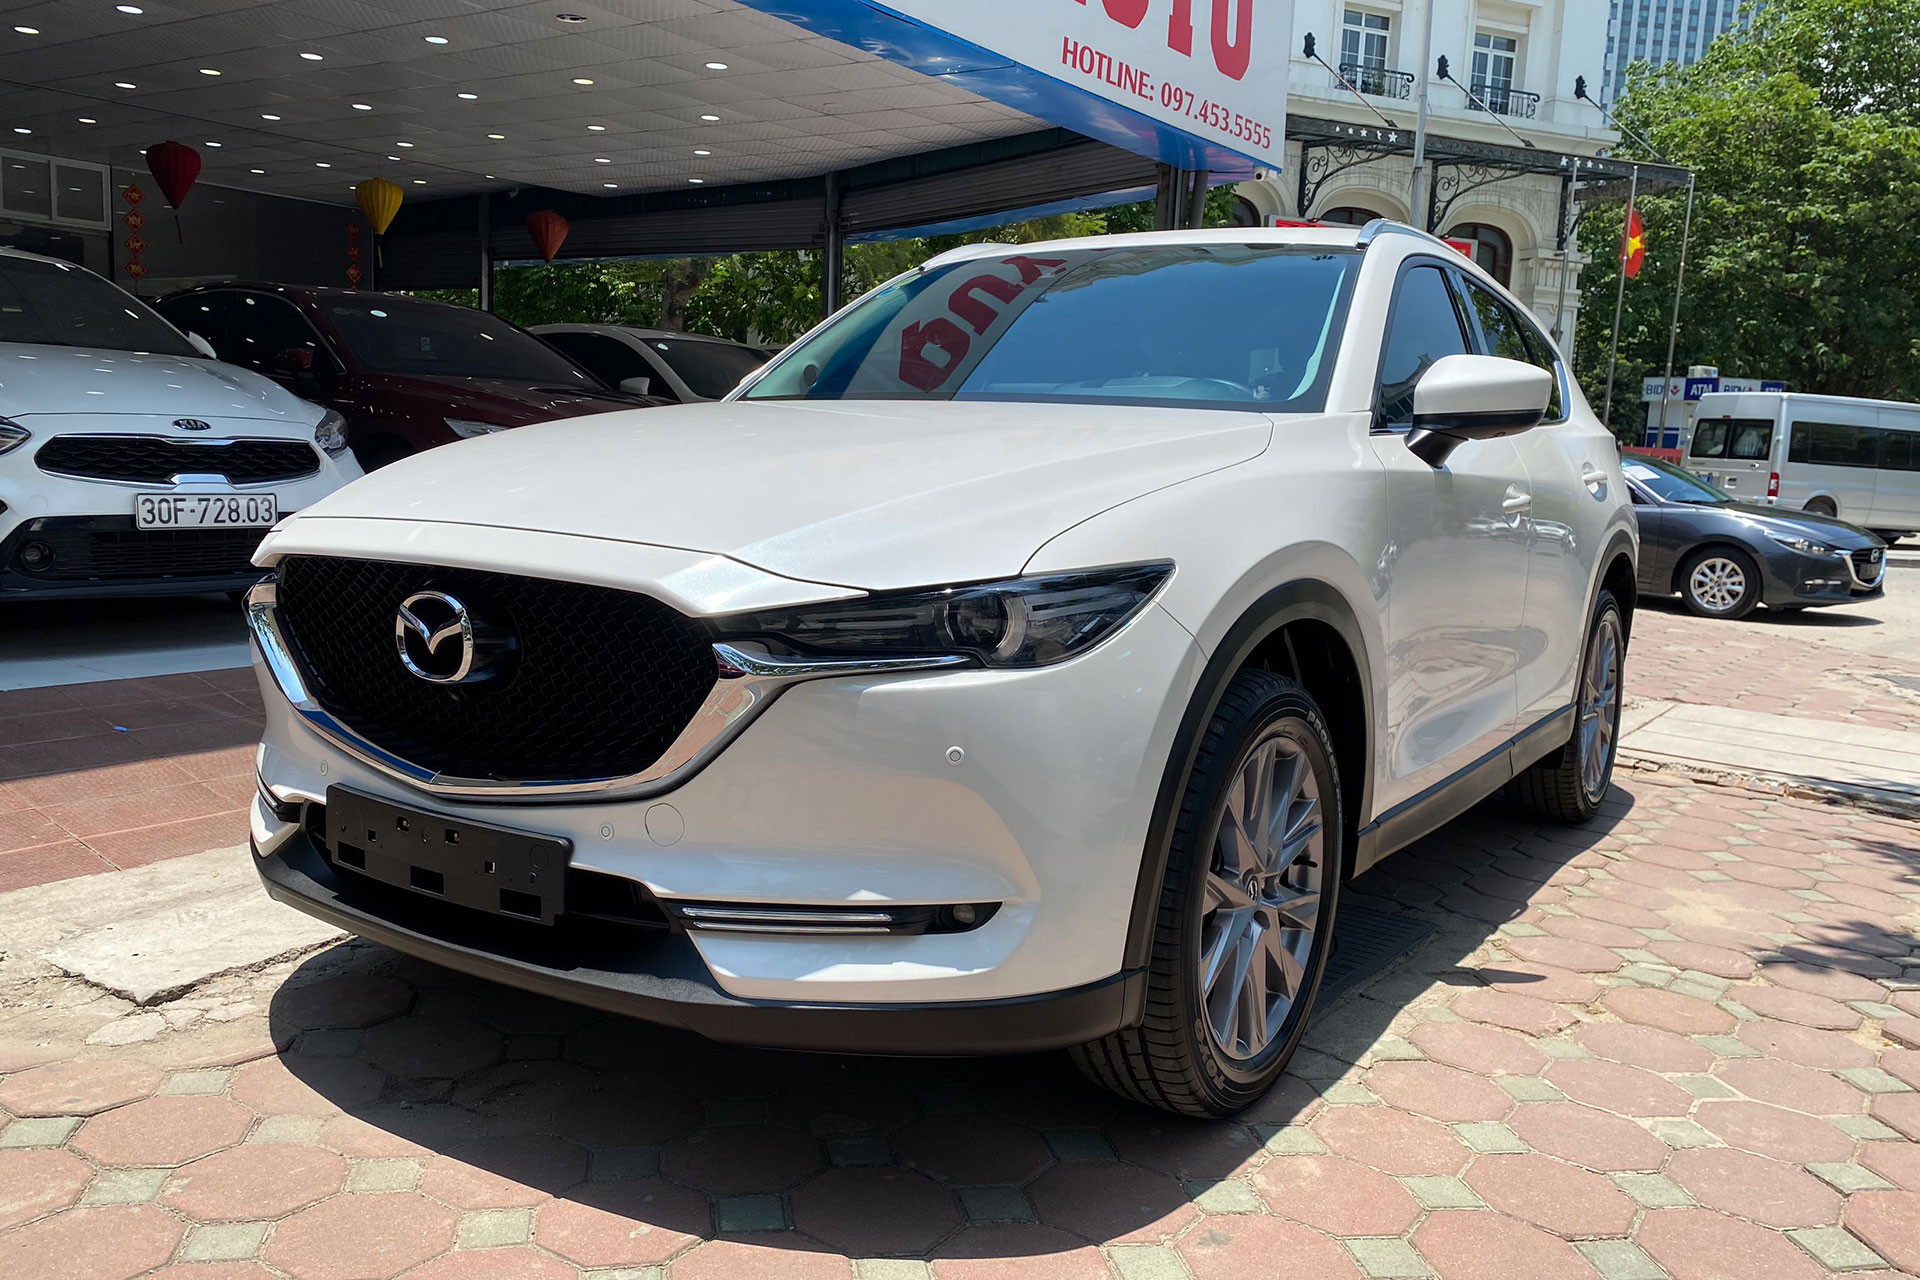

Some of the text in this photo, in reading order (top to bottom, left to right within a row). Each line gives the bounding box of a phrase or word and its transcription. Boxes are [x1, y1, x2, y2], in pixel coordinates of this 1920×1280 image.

[1062, 36, 1271, 149] HOTLINE: 097.453.5555
[141, 497, 273, 525] 30F-728.03
